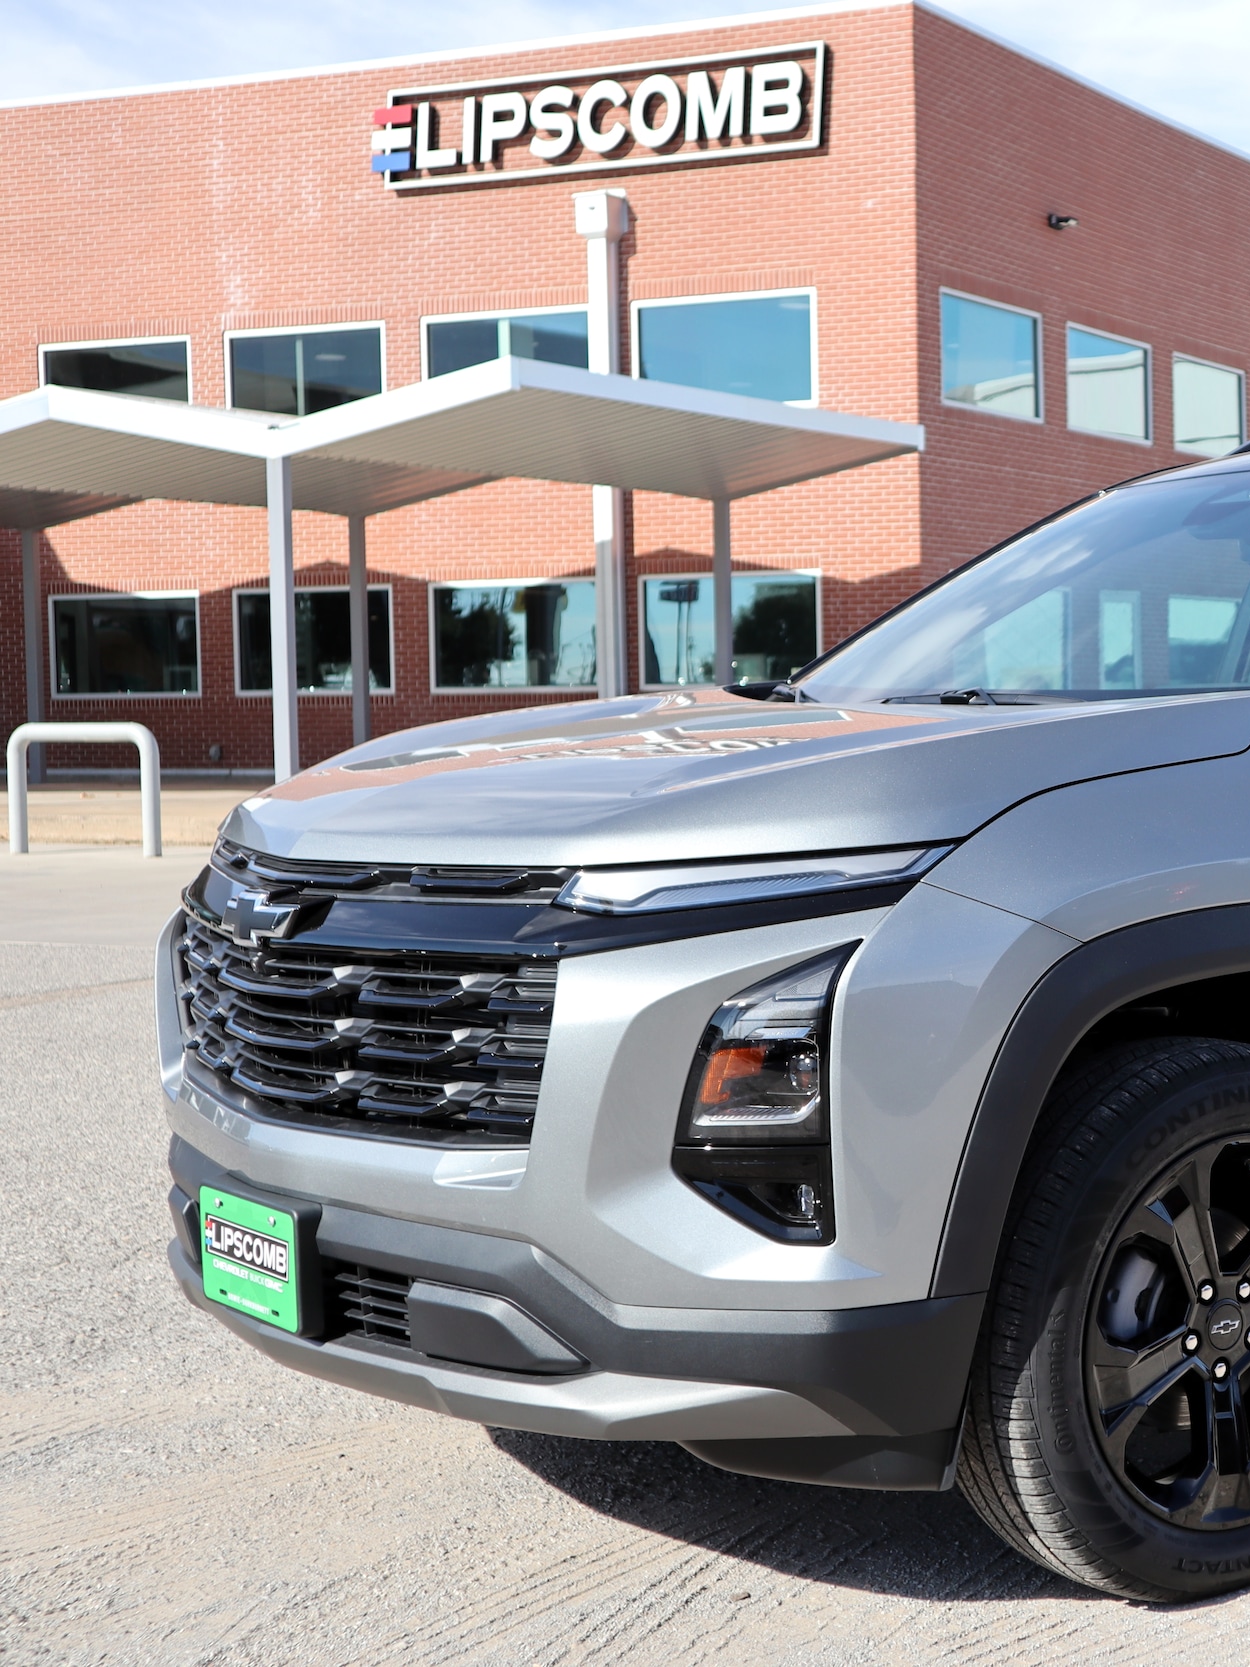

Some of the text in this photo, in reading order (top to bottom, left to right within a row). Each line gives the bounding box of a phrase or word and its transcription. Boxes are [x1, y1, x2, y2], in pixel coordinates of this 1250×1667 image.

[415, 60, 804, 170] LIPSCOMB
[211, 1221, 288, 1274] LIPSCOMB
[212, 1258, 249, 1280] CHEVROLET
